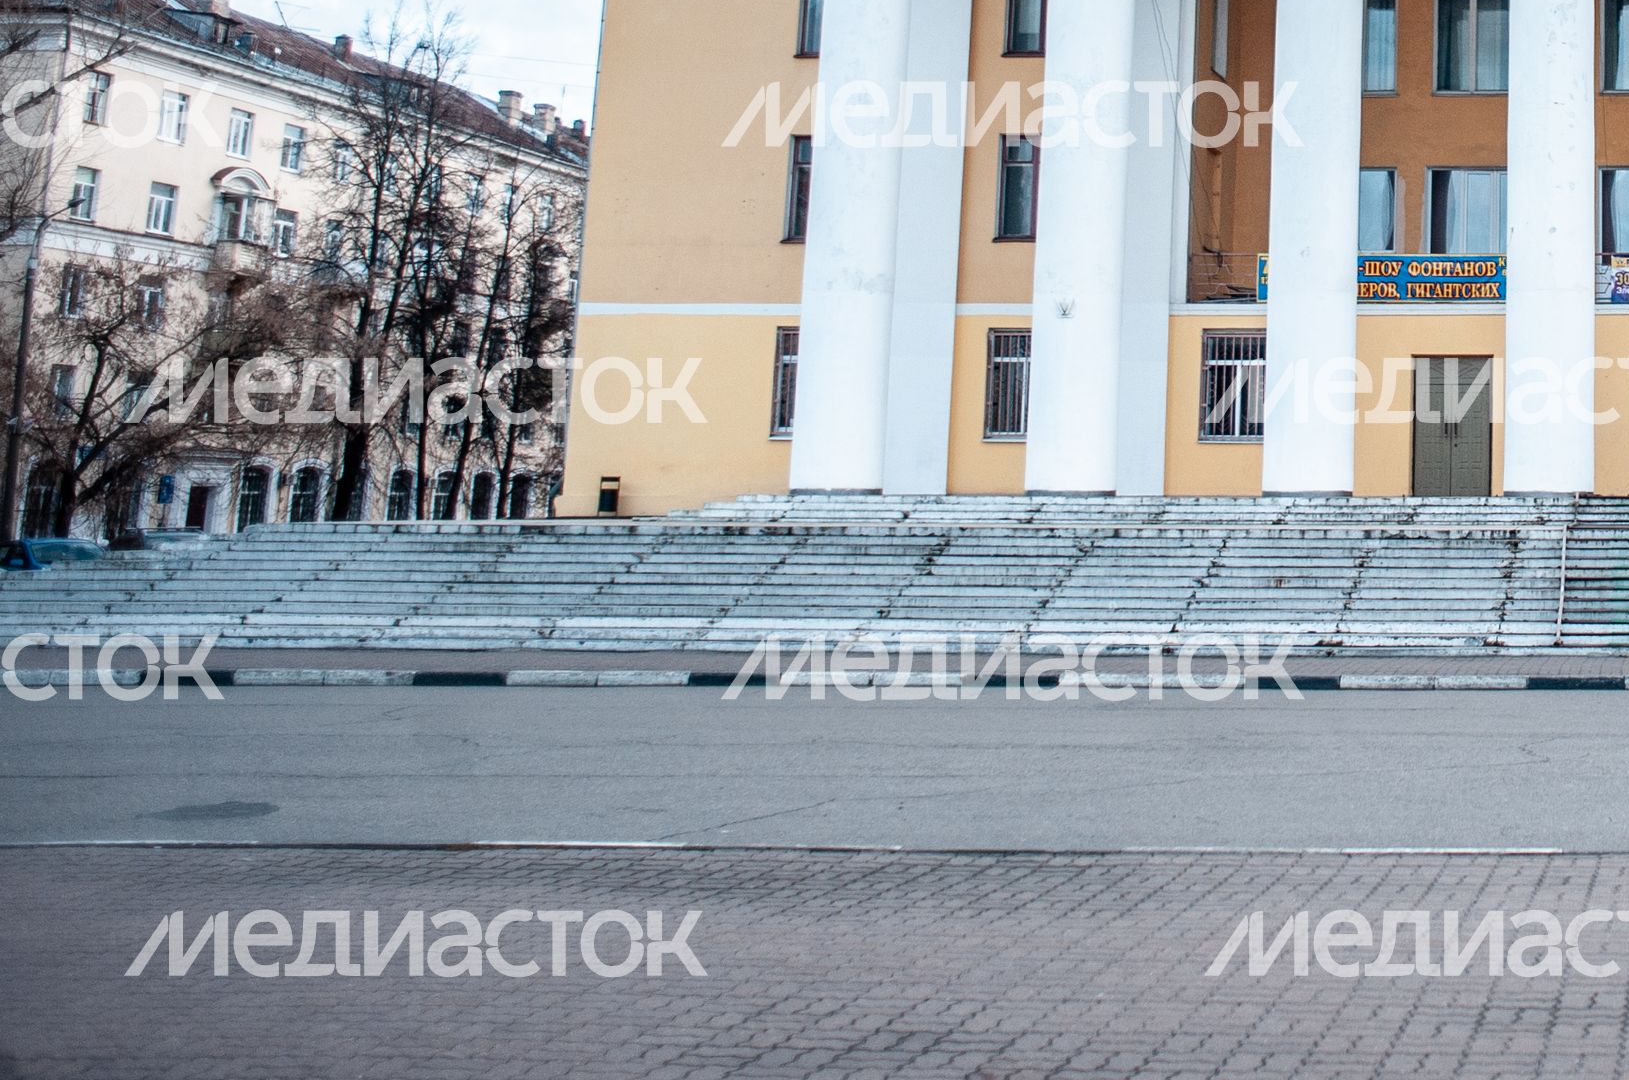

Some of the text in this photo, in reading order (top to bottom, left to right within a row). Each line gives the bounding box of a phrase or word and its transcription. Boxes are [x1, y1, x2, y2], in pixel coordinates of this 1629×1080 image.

[1408, 261, 1497, 277] ФОНТАНОВ
[1357, 282, 1500, 300] ЕРОВ, ГИГАНТСКИХ
